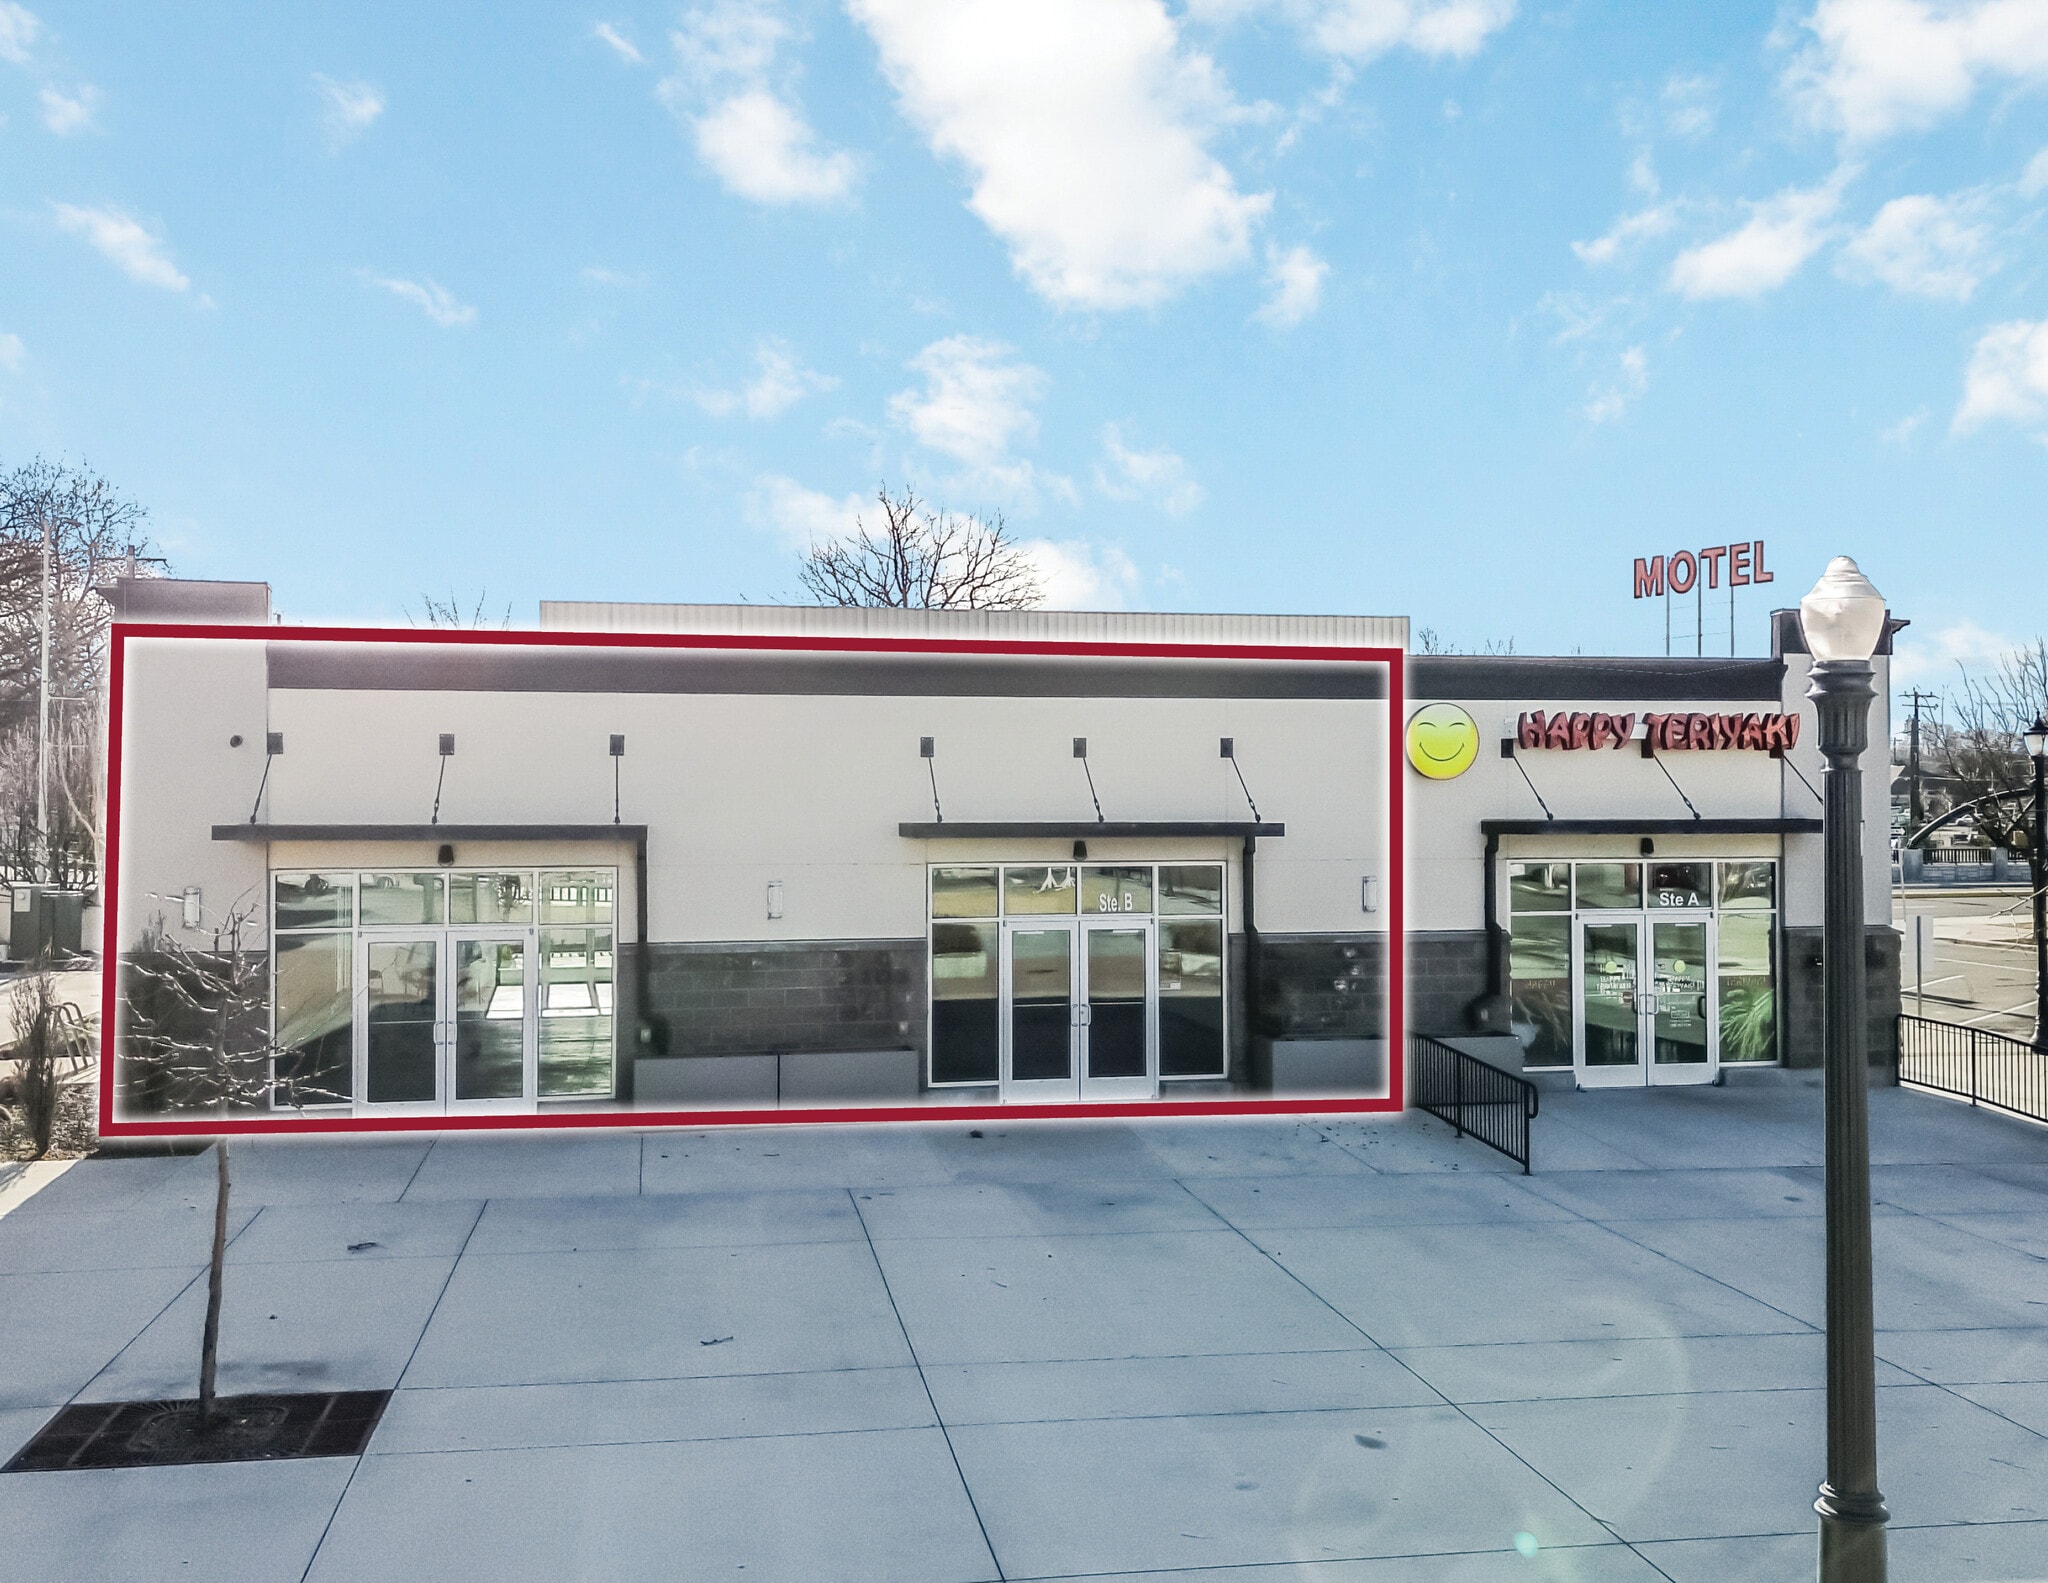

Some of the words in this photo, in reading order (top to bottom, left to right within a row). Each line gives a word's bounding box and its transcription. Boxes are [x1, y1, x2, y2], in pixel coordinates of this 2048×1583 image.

[1634, 540, 1774, 599] MOTEL
[1517, 710, 1636, 750] HAPPY
[1643, 712, 1801, 750] TERIYAKI
[1099, 893, 1121, 912] Ste.
[1124, 892, 1133, 911] B
[1659, 892, 1684, 906] Ste
[1687, 892, 1700, 906] A
